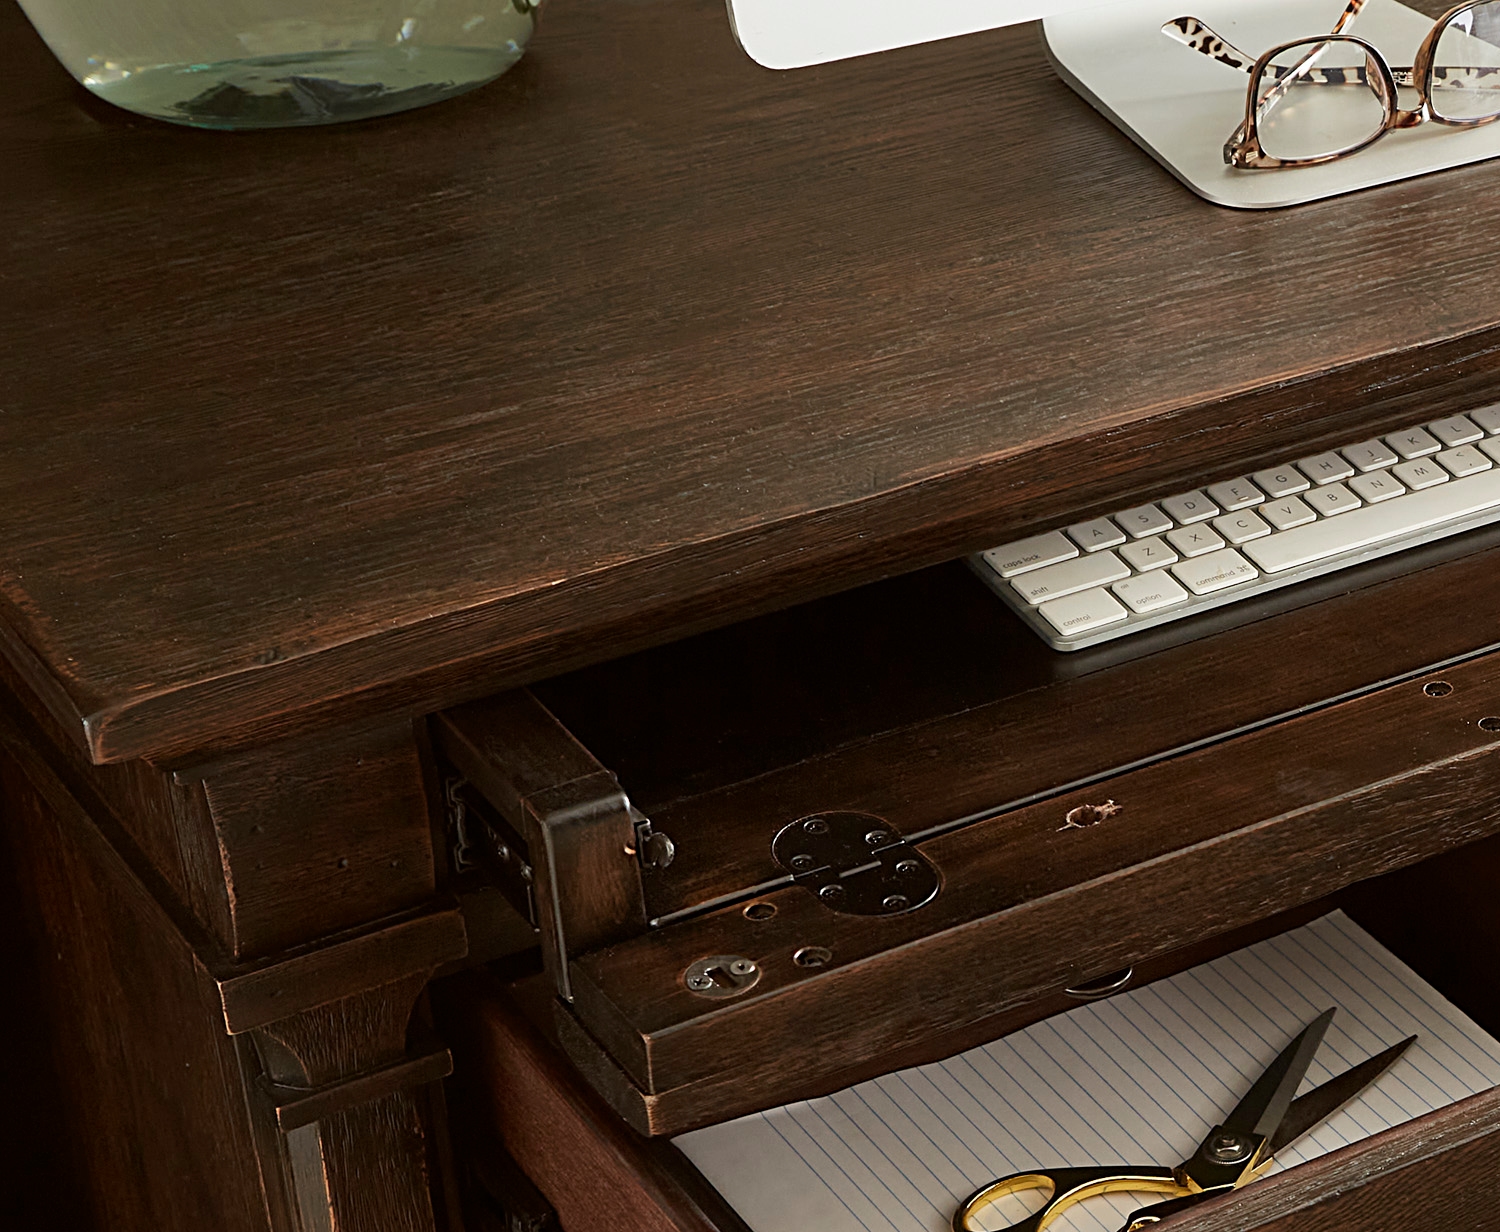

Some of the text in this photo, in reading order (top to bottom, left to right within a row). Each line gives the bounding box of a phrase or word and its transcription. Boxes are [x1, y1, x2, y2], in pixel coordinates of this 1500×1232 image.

[1003, 553, 1042, 570] caps lock
[1195, 569, 1235, 587] command
[1030, 586, 1049, 596] shift
[1136, 593, 1162, 604] option
[1062, 613, 1091, 627] control
